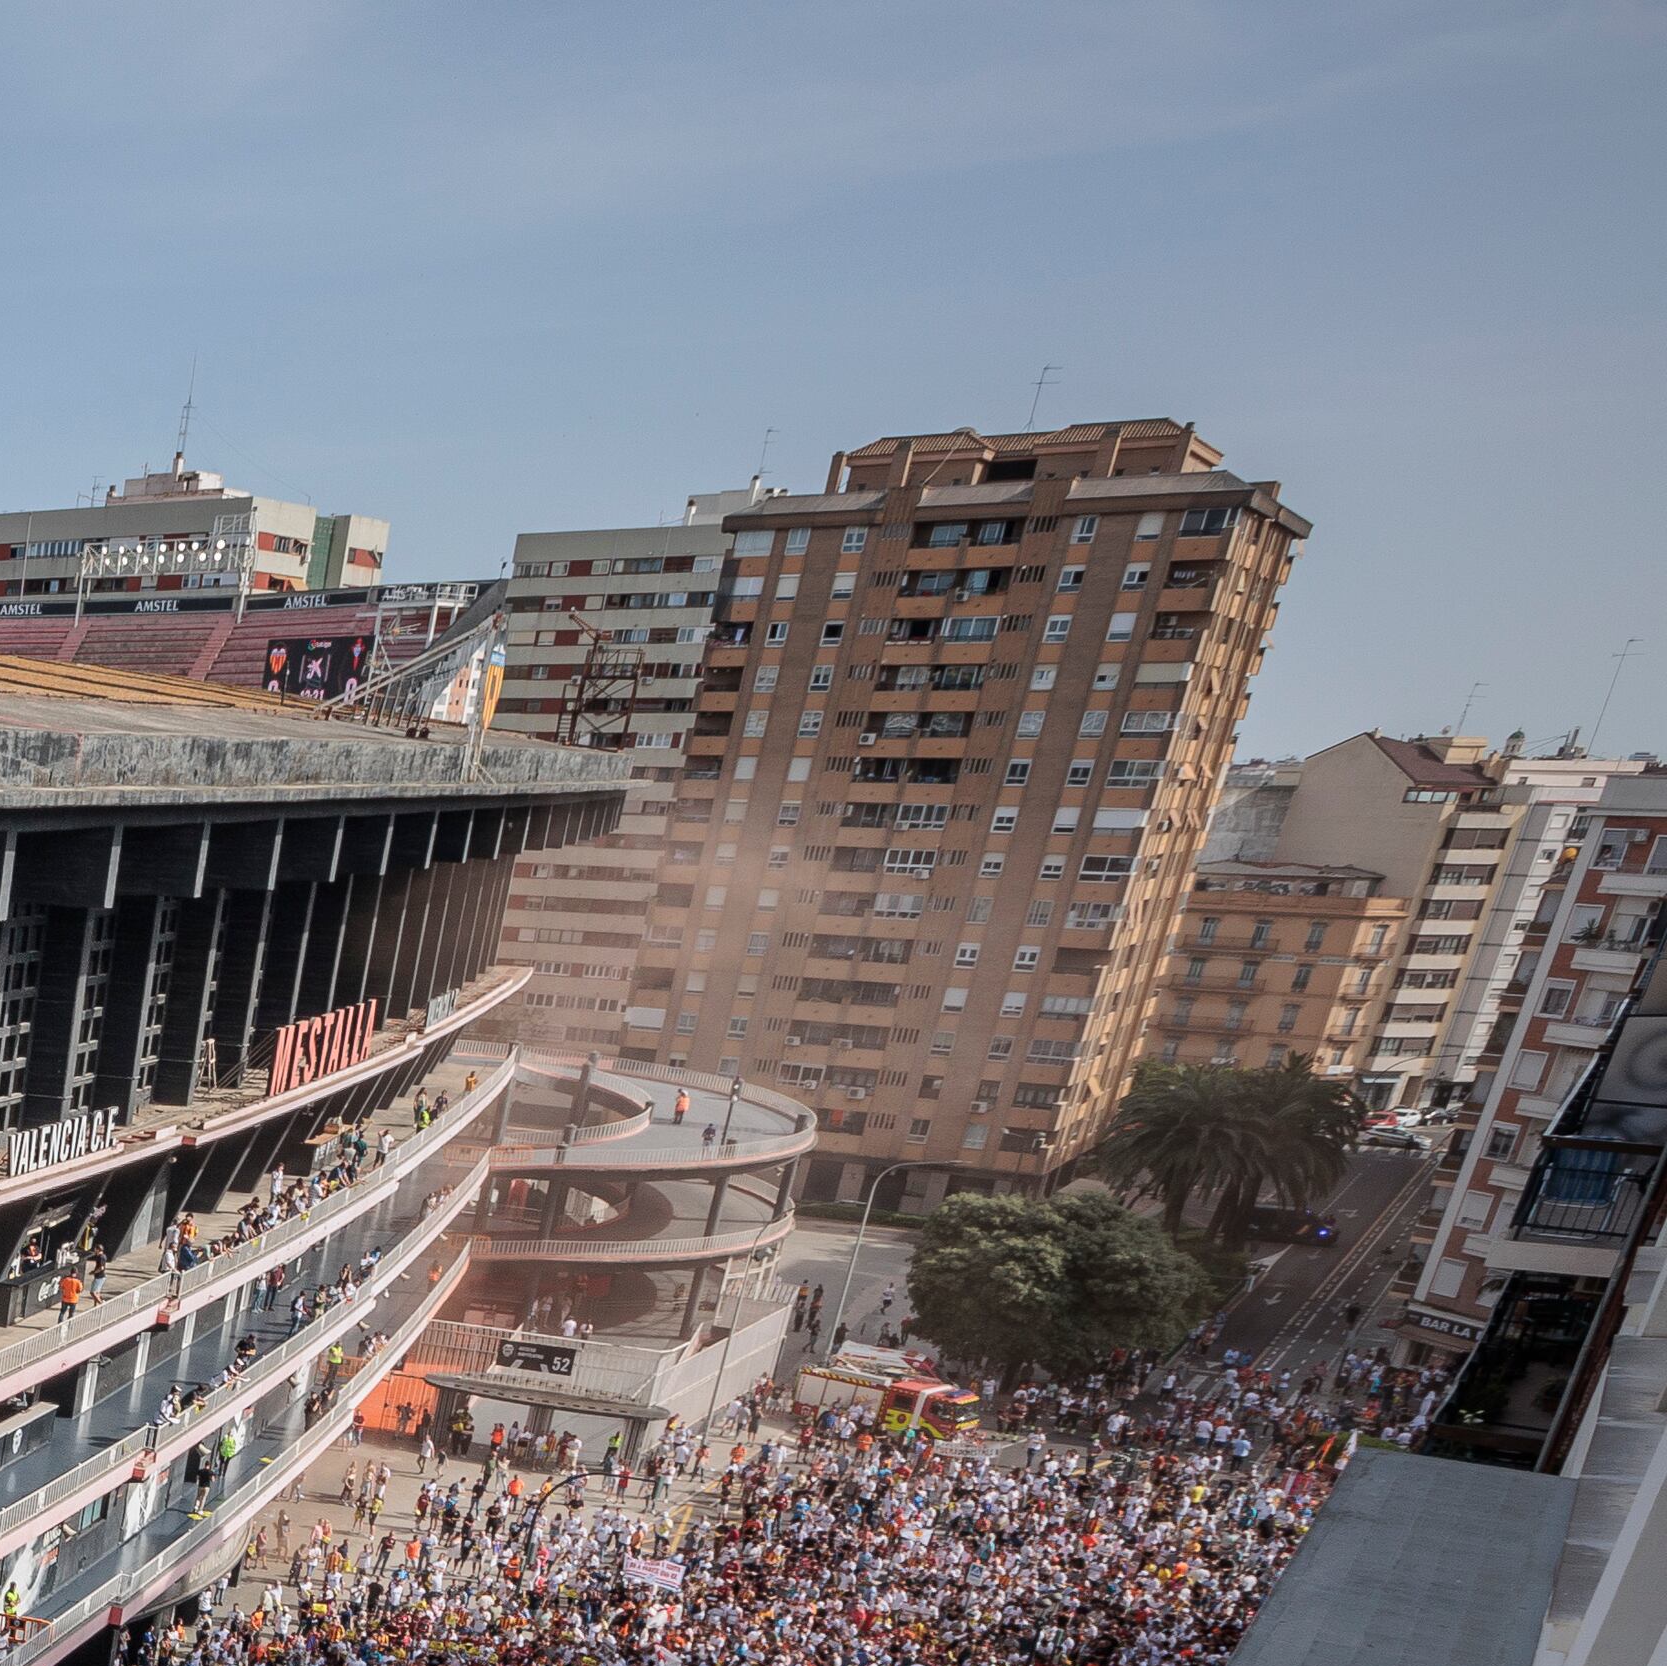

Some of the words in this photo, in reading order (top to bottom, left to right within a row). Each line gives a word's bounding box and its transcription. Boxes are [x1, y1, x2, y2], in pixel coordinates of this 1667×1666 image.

[133, 598, 180, 613] AMSTEL
[282, 592, 328, 609] AMSTEL
[0, 602, 43, 616] AMSTEL
[269, 998, 378, 1098] MESTALLA
[7, 1114, 88, 1177] VALENCIA
[551, 1356, 571, 1372] 52
